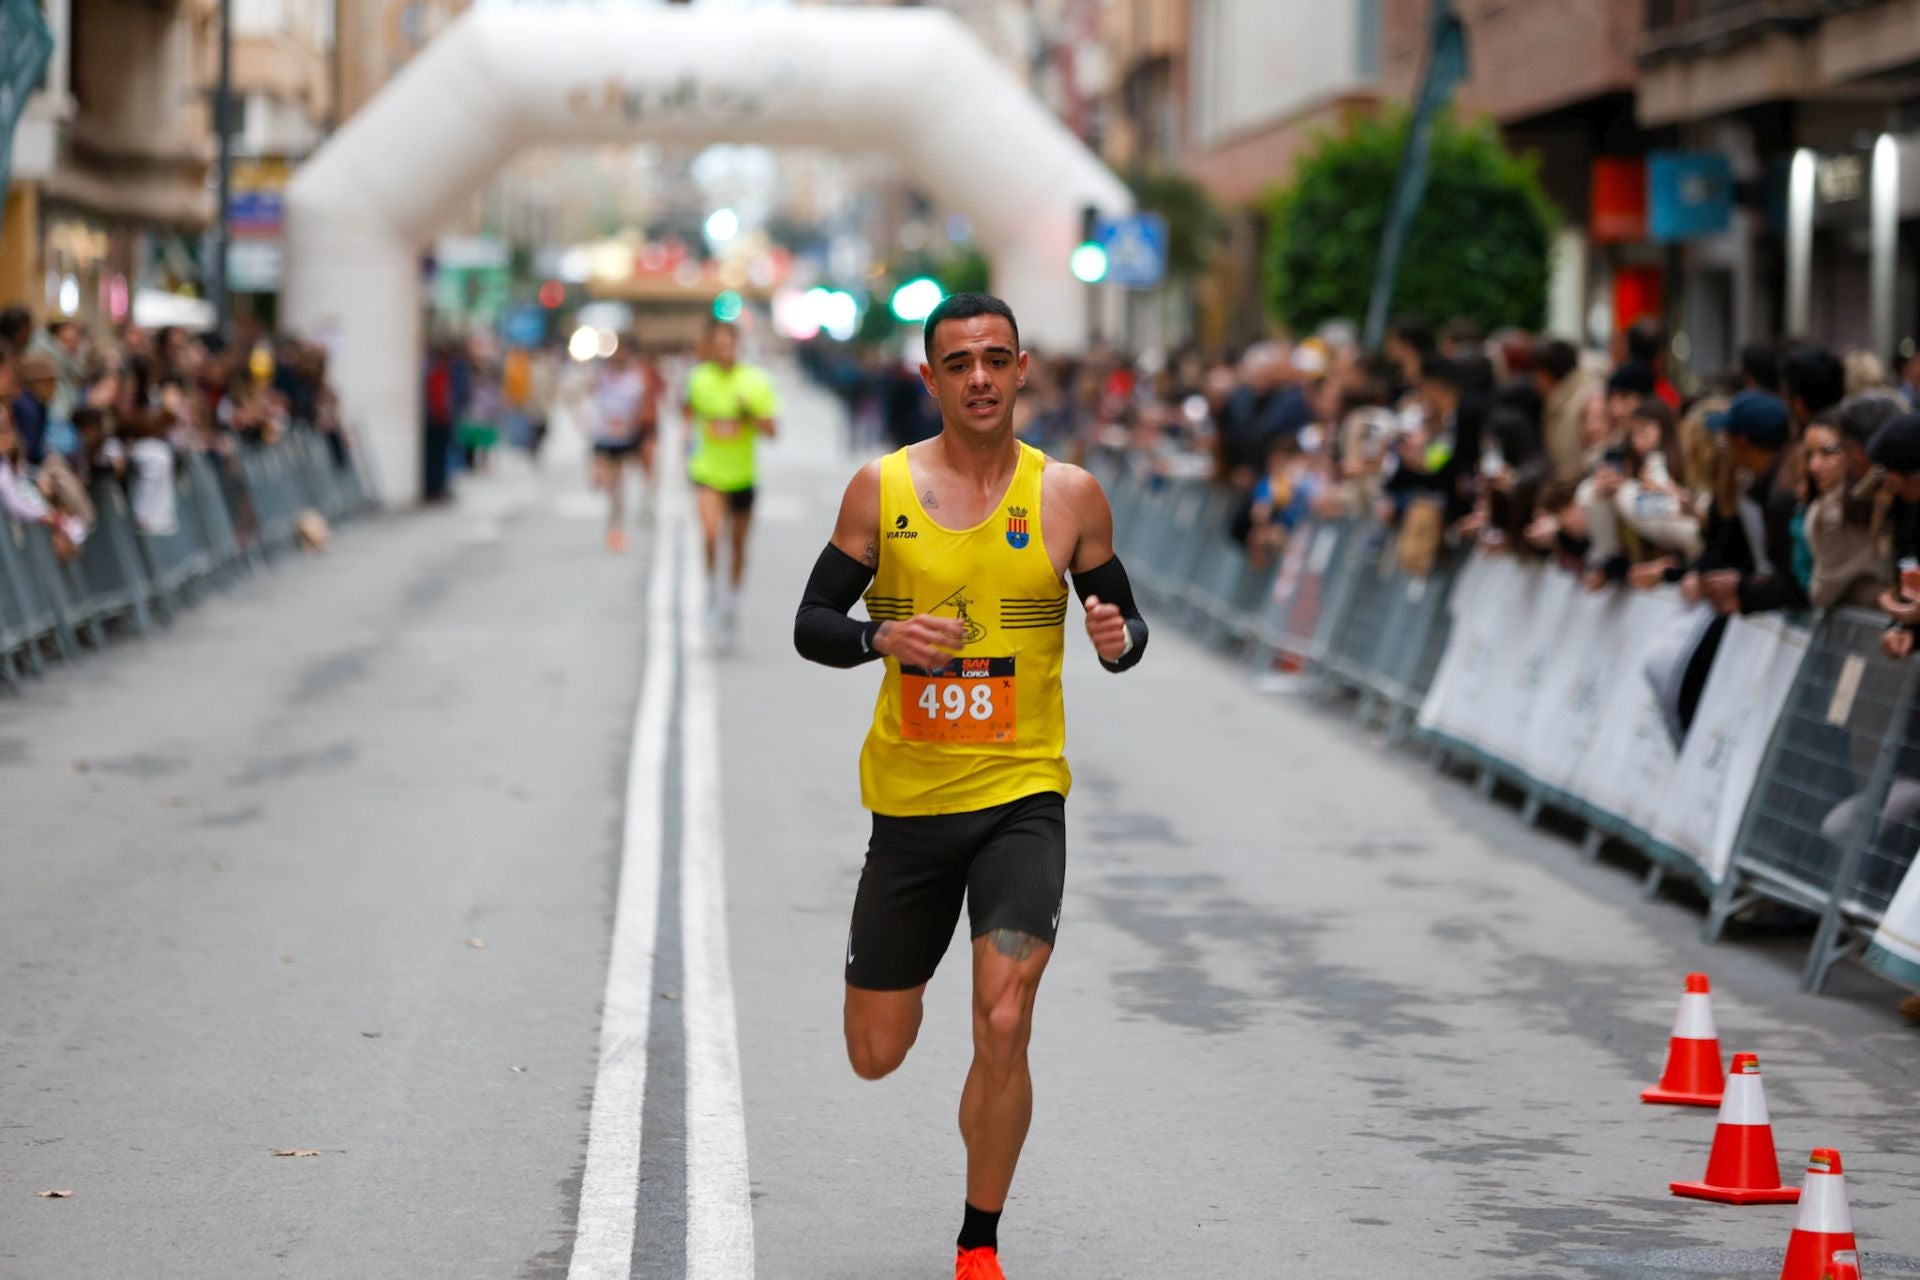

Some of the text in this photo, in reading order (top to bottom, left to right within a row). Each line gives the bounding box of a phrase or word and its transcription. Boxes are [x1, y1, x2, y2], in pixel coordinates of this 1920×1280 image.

[886, 531, 918, 539] VIATOR
[962, 658, 990, 669] SAN
[962, 670, 990, 678] LORCA
[918, 683, 994, 721] 498
